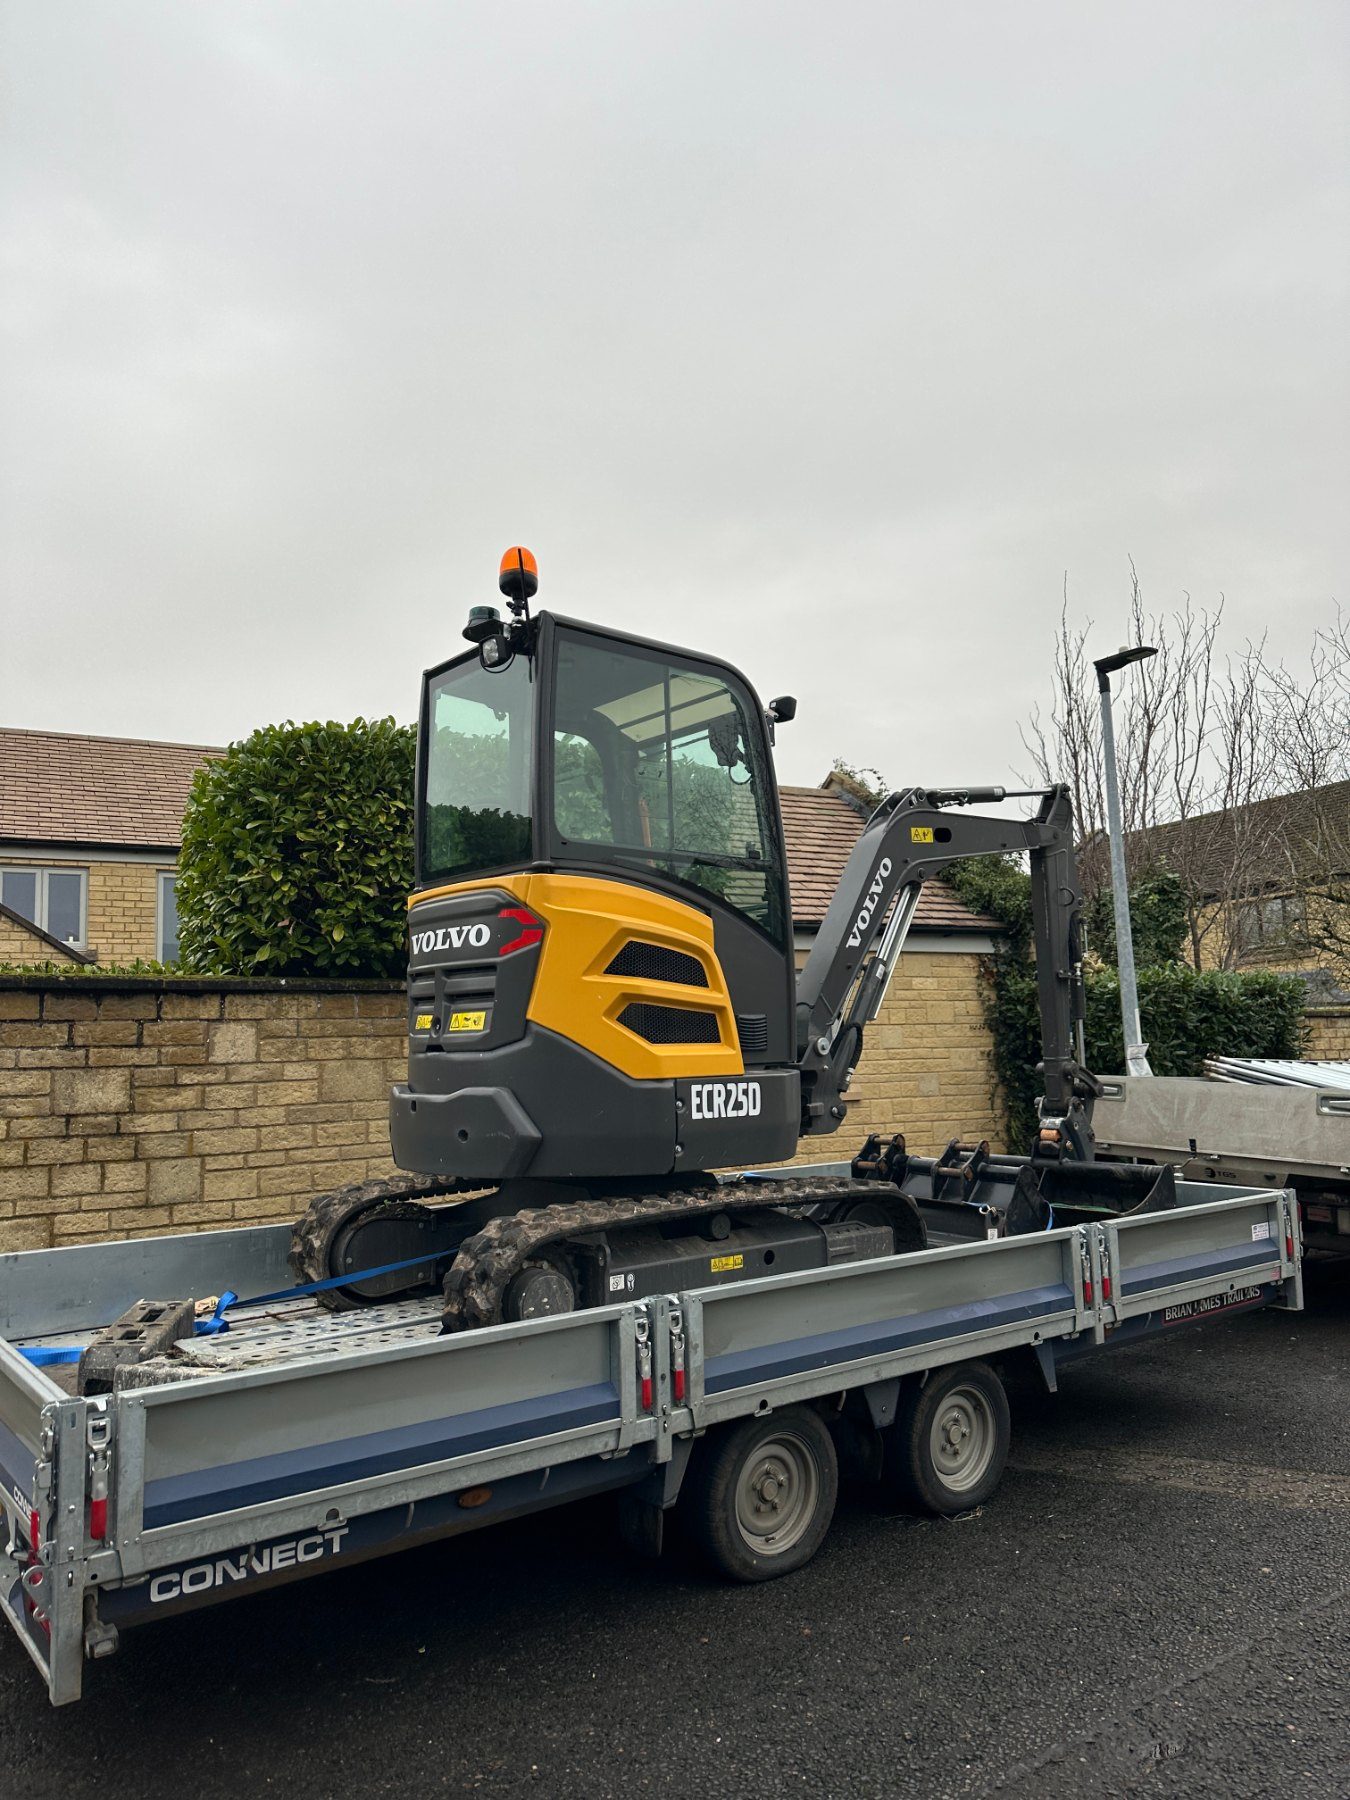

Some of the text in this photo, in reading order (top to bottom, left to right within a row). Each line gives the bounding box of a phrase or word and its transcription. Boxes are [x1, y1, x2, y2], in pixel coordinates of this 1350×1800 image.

[845, 857, 892, 949] VOLVO
[411, 923, 491, 955] VOLVO
[690, 1082, 761, 1120] ECR25D
[1165, 1302, 1192, 1320] BRIAN
[150, 1527, 349, 1603] CONNECT
